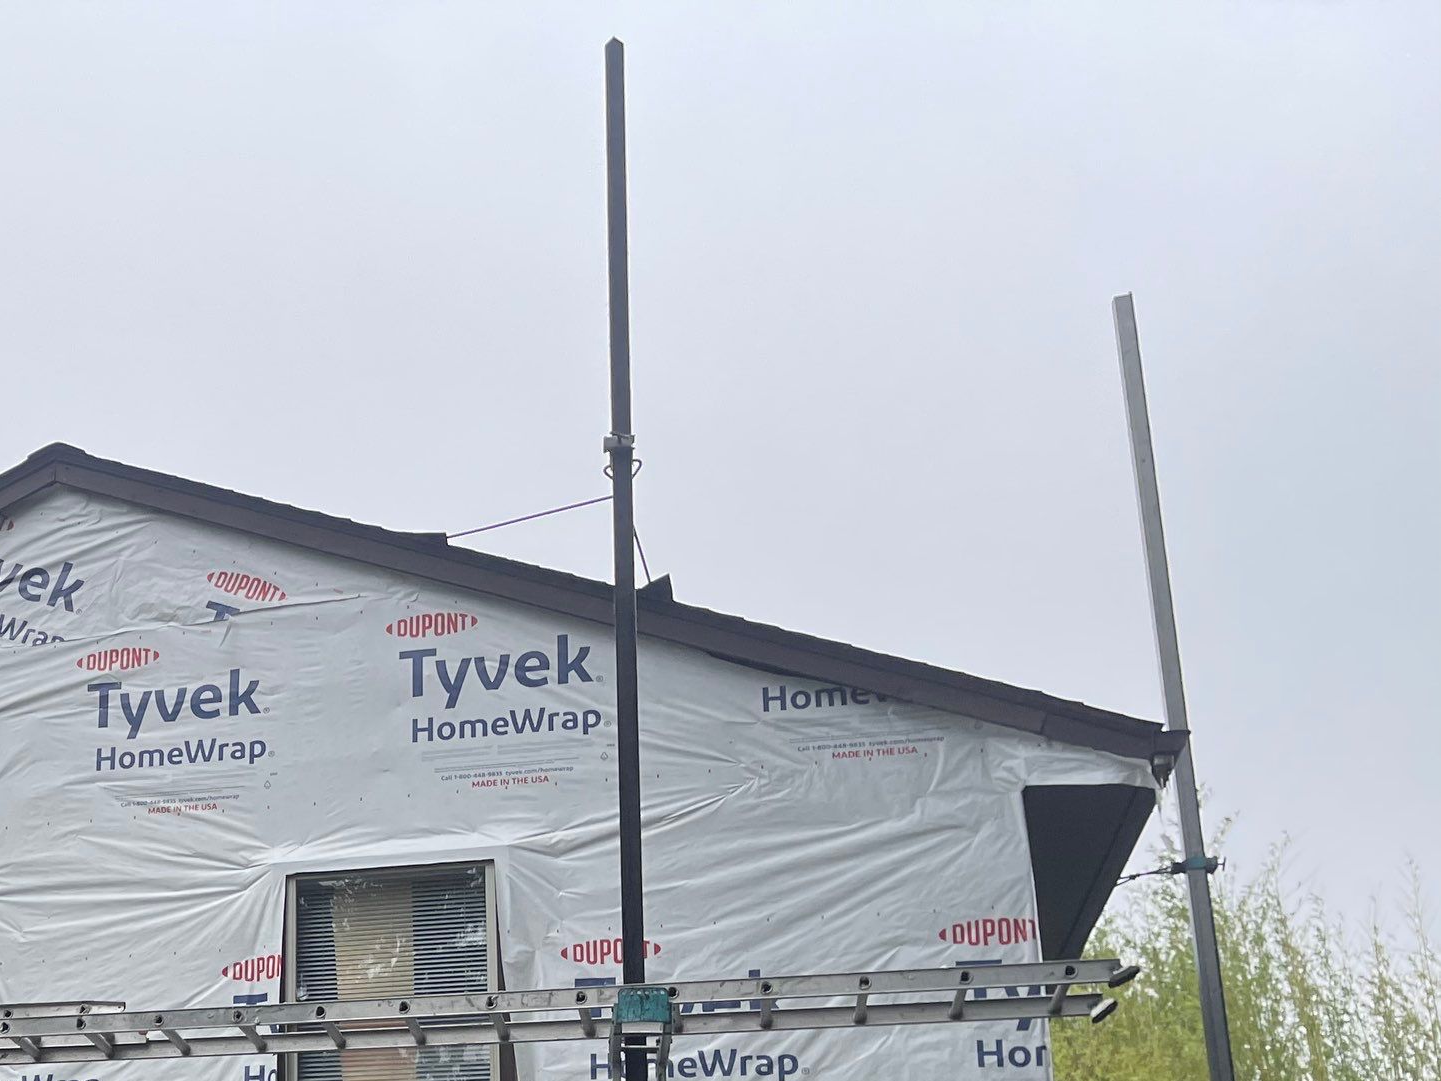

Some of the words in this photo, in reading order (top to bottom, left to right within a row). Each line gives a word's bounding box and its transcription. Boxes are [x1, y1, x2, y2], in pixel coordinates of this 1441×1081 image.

[214, 571, 280, 601] DUPONT
[397, 612, 468, 638] DUPONT
[87, 647, 151, 671] DUPONT
[399, 634, 594, 709] Tyvek
[87, 668, 261, 740] Tyvek
[412, 707, 602, 743] HomeWrap
[96, 738, 267, 771] HomeWrap
[832, 751, 862, 760] MADE
[863, 749, 874, 758] IN
[876, 748, 896, 757] THE
[897, 746, 919, 755] USA
[471, 780, 499, 789] MADE
[500, 779, 510, 787] IN
[512, 778, 529, 786] THE
[531, 776, 550, 784] USA
[147, 806, 172, 814] MADE
[173, 805, 182, 813] IN
[184, 804, 199, 812] THE
[200, 803, 218, 811] USA
[572, 938, 650, 965] DUPOT
[590, 1049, 799, 1081] HeWrap
